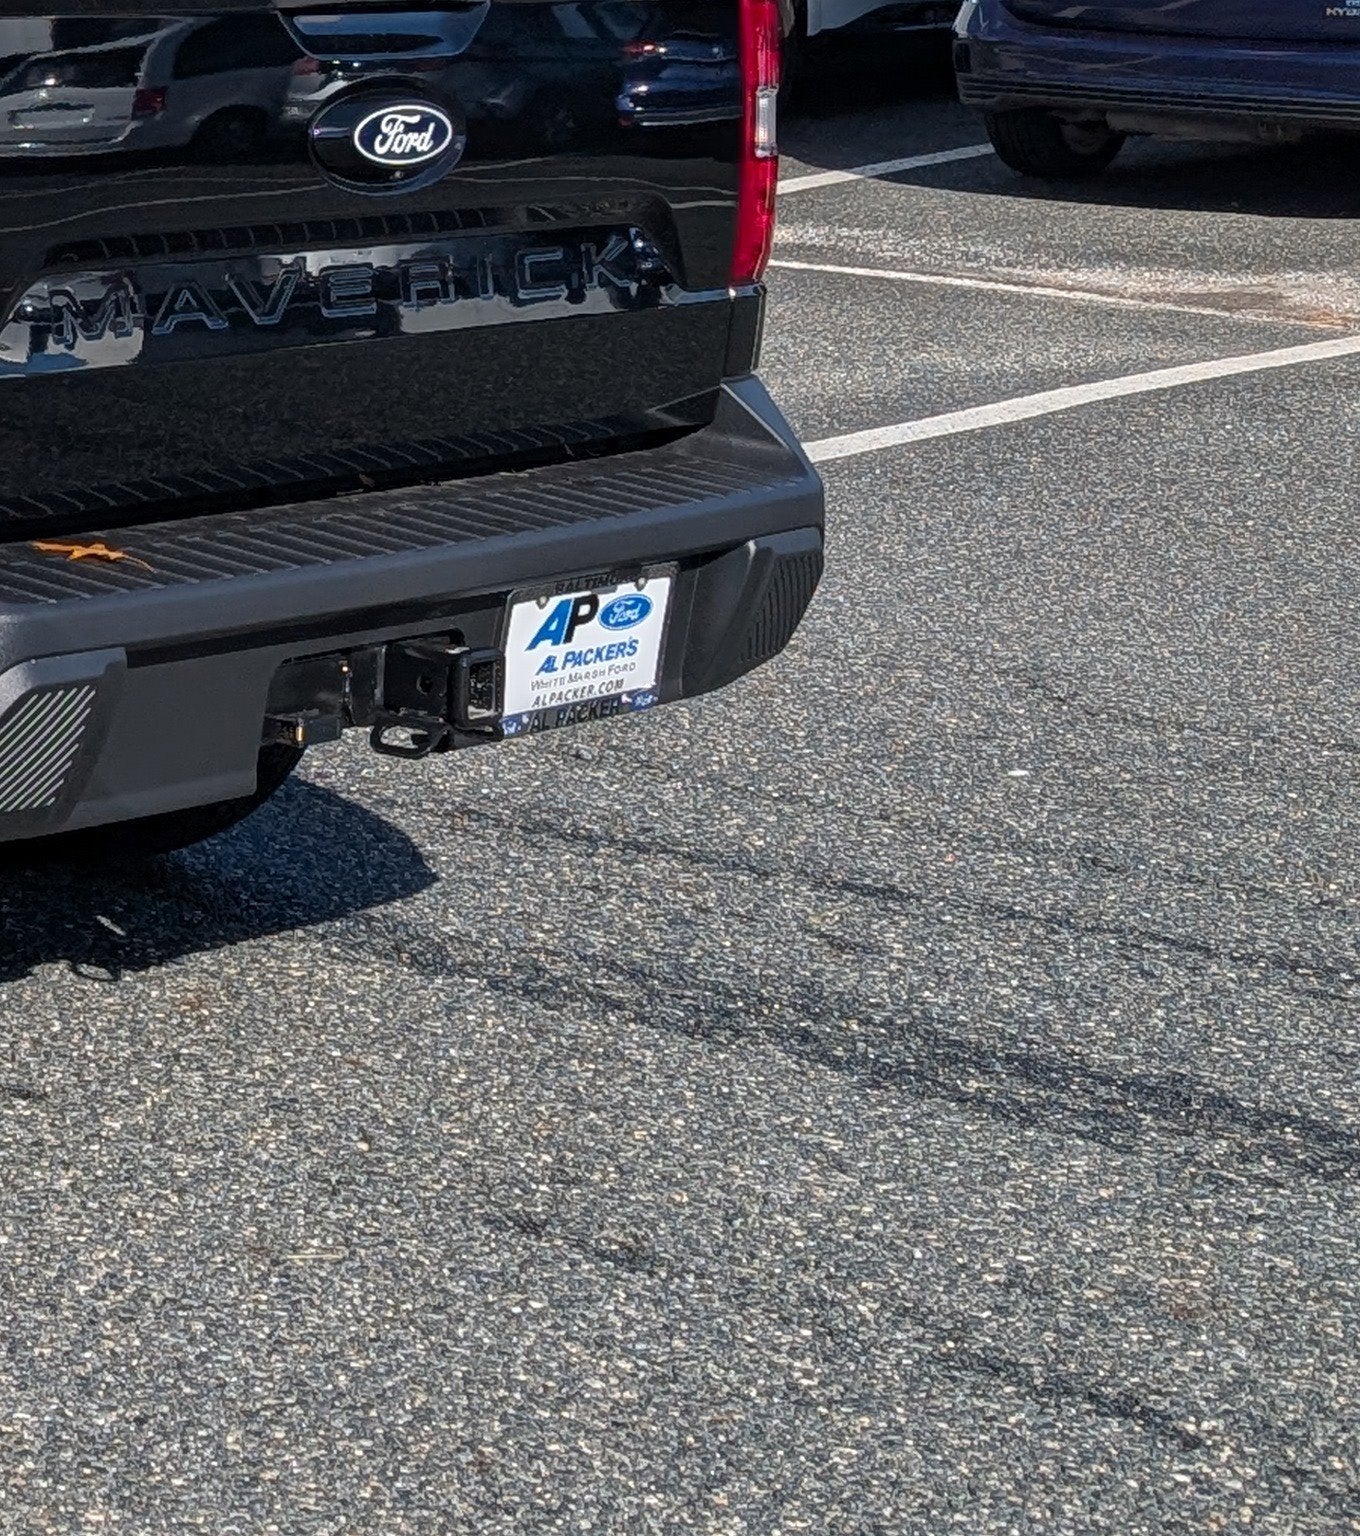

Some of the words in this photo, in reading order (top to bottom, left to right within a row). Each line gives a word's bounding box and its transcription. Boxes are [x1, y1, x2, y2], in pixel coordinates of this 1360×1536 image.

[373, 113, 436, 156] Ford
[48, 234, 635, 346] MAVERICK
[524, 593, 600, 652] AP
[536, 655, 559, 676] AL
[561, 636, 640, 671] PACKER'S
[607, 661, 636, 675] FORD
[531, 677, 625, 709] ALPACKER.COM
[555, 698, 621, 726] PACKER
